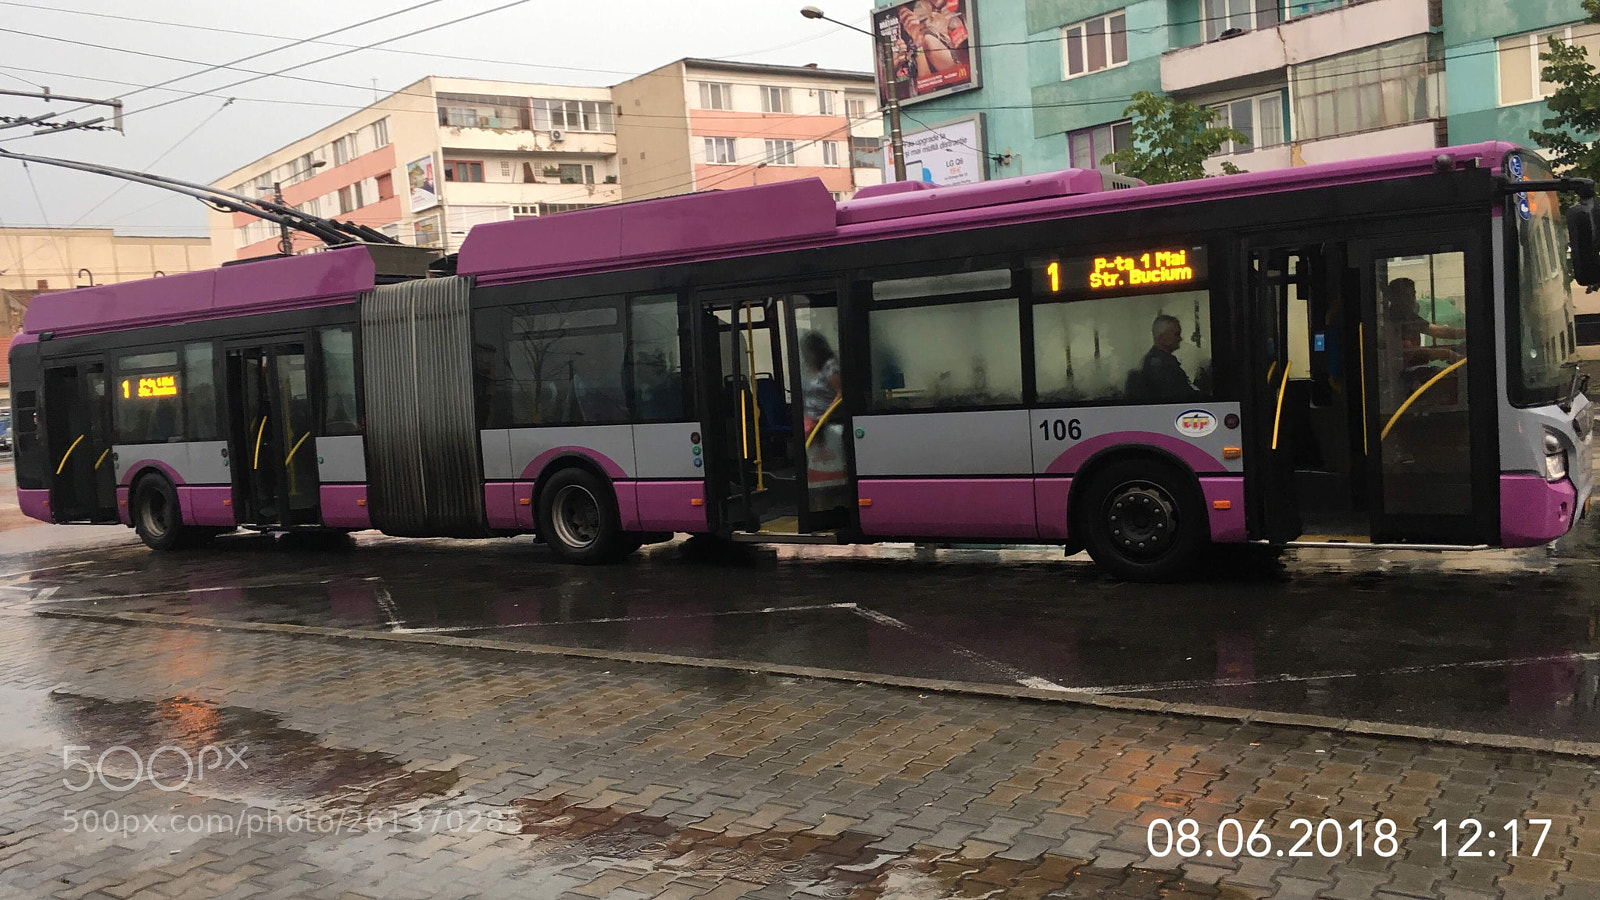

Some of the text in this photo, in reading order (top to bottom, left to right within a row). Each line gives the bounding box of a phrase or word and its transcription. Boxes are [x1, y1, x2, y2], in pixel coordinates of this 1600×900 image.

[946, 160, 954, 168] LG
[1094, 250, 1186, 272] P-ta 1 Mai
[1047, 262, 1059, 292] 1
[1089, 266, 1193, 288] Str. Bucium
[122, 380, 130, 399] 1
[1039, 418, 1082, 441] 106
